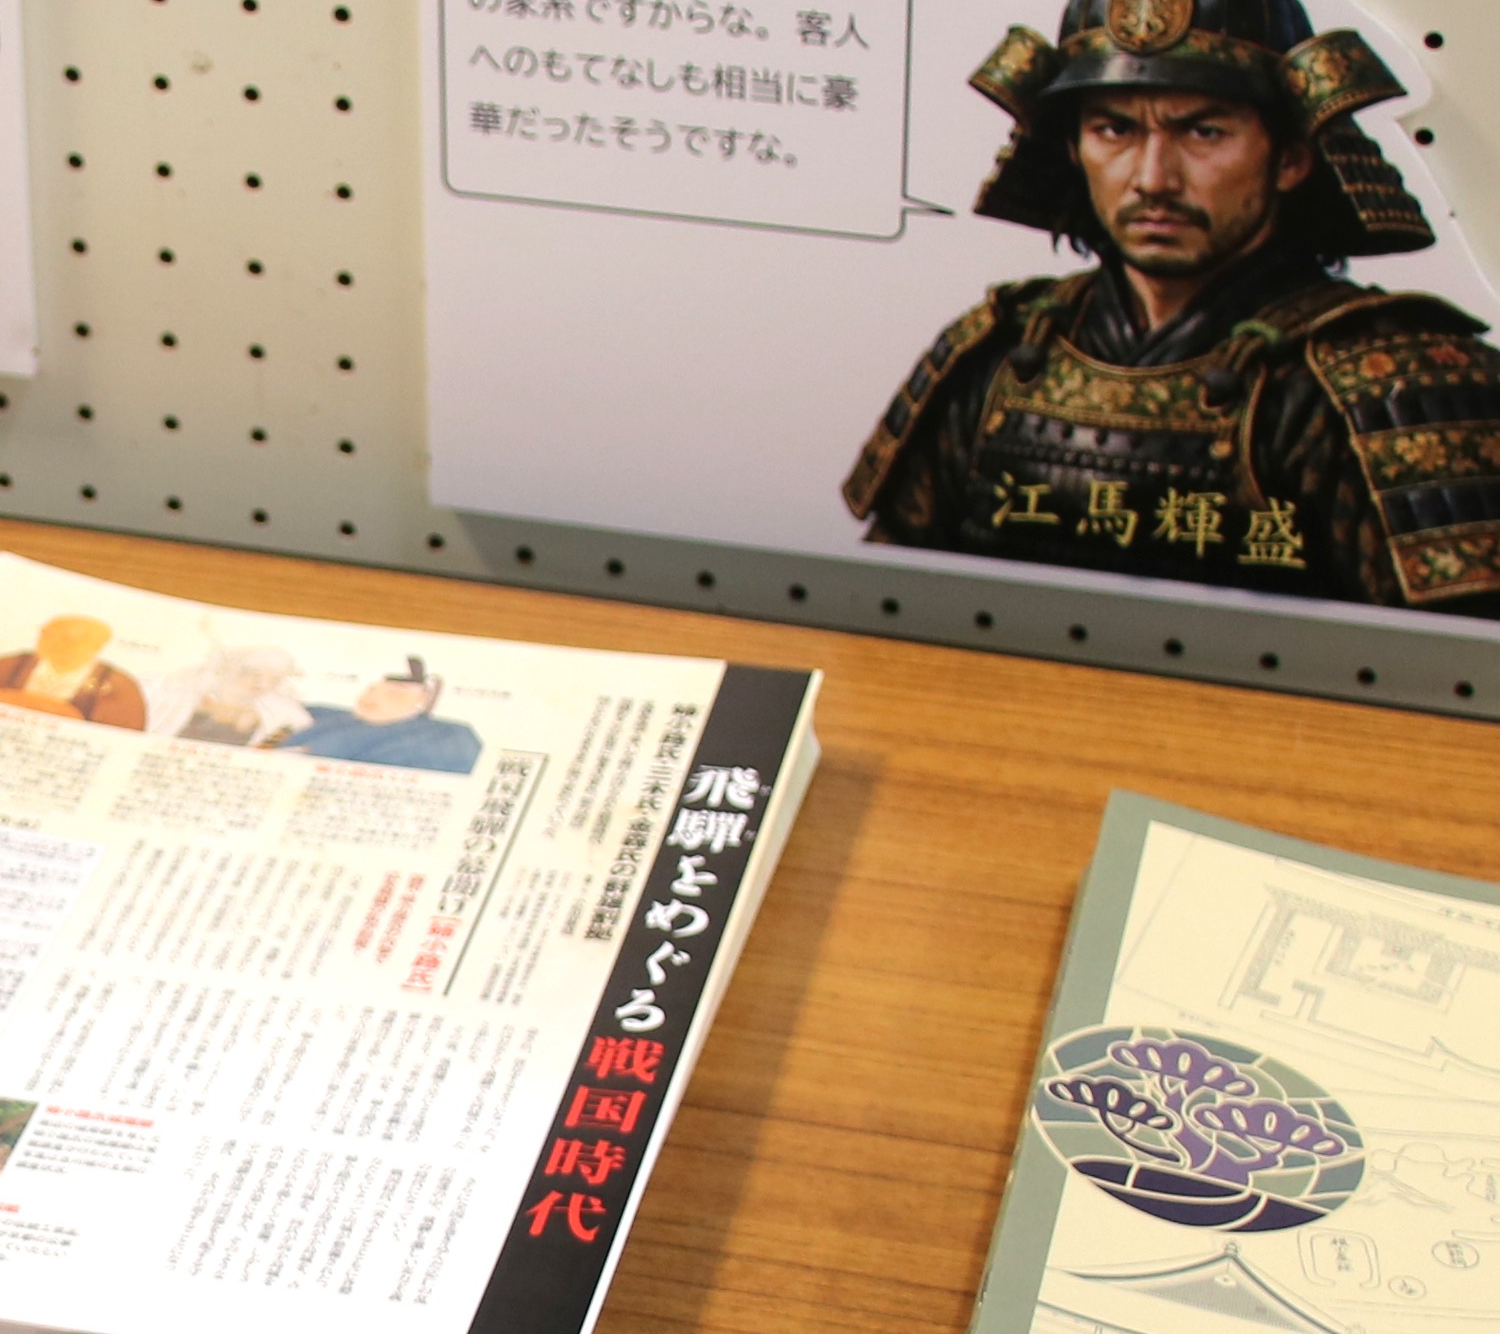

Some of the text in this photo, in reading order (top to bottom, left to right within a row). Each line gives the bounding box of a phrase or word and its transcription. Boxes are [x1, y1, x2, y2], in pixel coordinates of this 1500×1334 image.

[469, 44, 860, 112] へのもてなしも相当に豪
[469, 101, 799, 167] 華だったそうですな。
[990, 472, 1306, 569] 江馬輝盛
